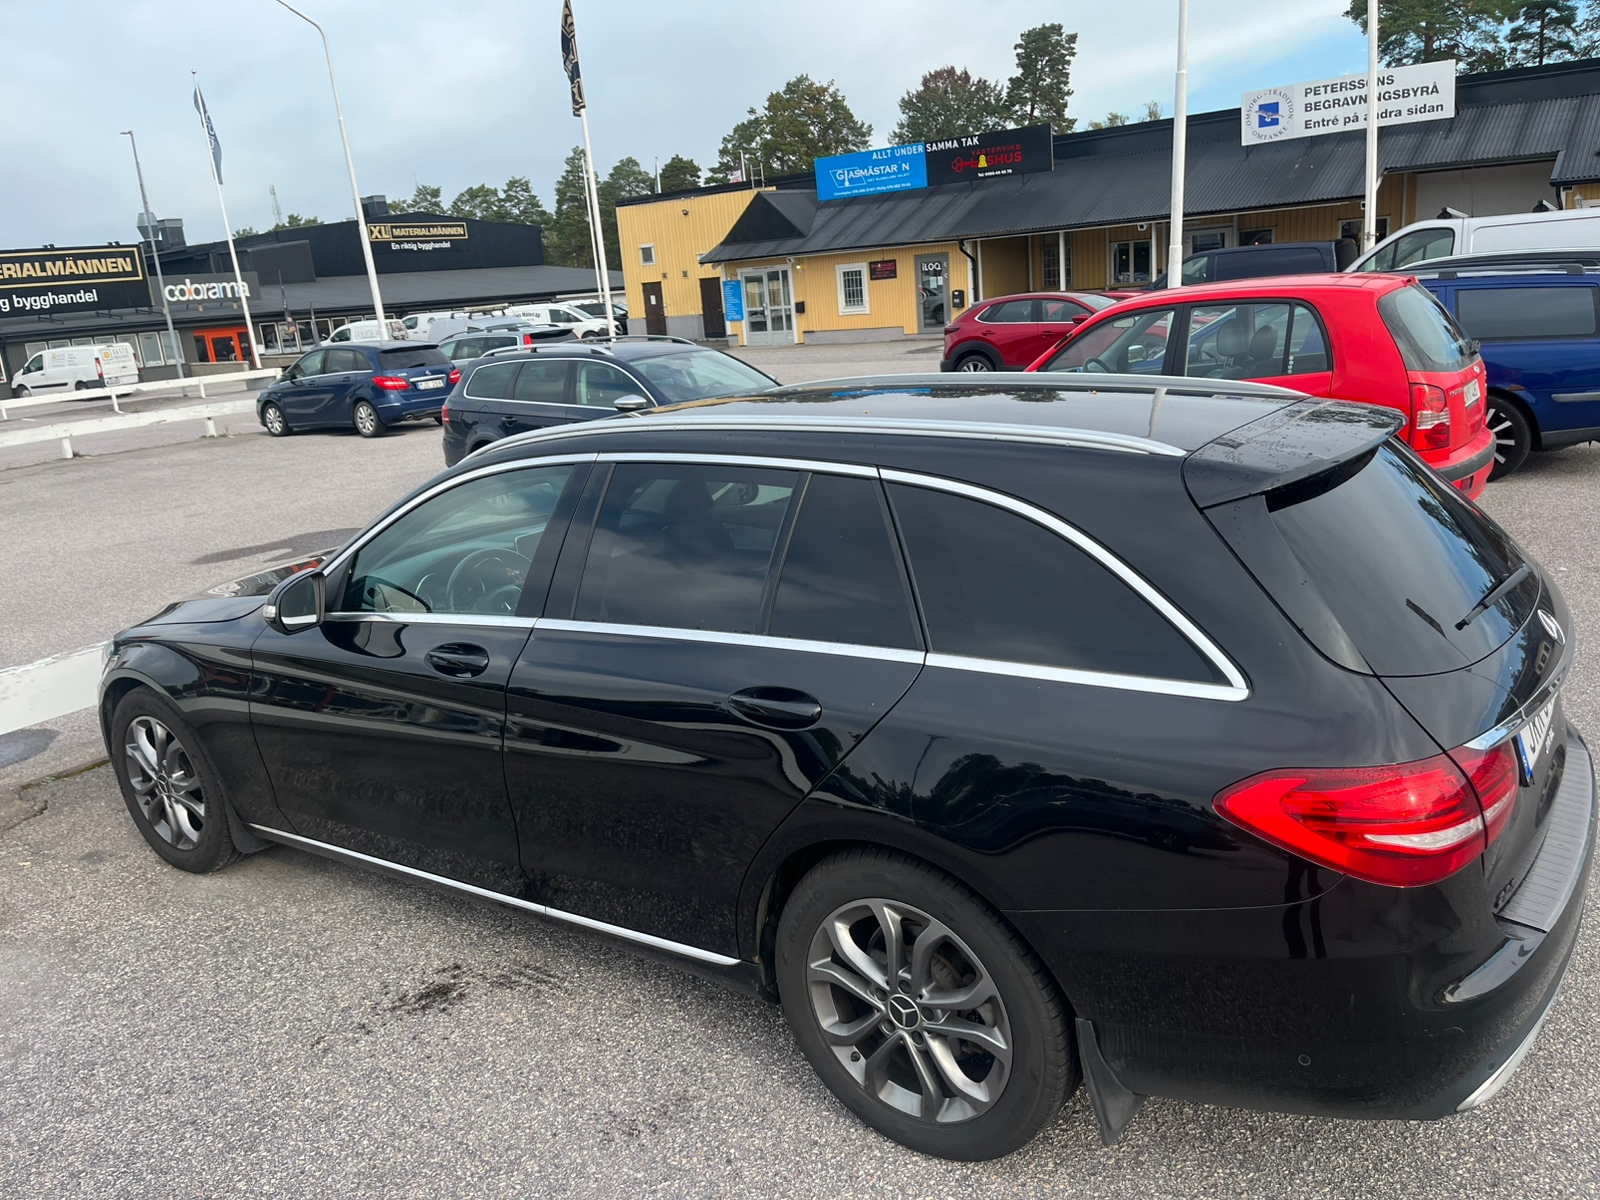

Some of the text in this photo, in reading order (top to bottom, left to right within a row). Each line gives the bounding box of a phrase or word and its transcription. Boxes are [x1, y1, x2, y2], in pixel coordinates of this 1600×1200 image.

[1304, 75, 1395, 97] PETERSSNS
[1304, 82, 1440, 112] BEGRAVNNGSBYRÅ
[1268, 89, 1294, 119] TRADITION
[1304, 117, 1338, 129] Entré
[1343, 112, 1359, 126] på
[1406, 103, 1444, 116] sidan
[872, 136, 980, 160] ALLT UNDER SAMMA TAK
[369, 226, 464, 239] XL MATERIALMÄNNEN
[401, 242, 417, 250] riktig
[417, 241, 451, 250] bygghandel
[0, 257, 133, 280] RIALMÄNNEN
[12, 289, 98, 310] bygghandel
[164, 279, 250, 301] colorama
